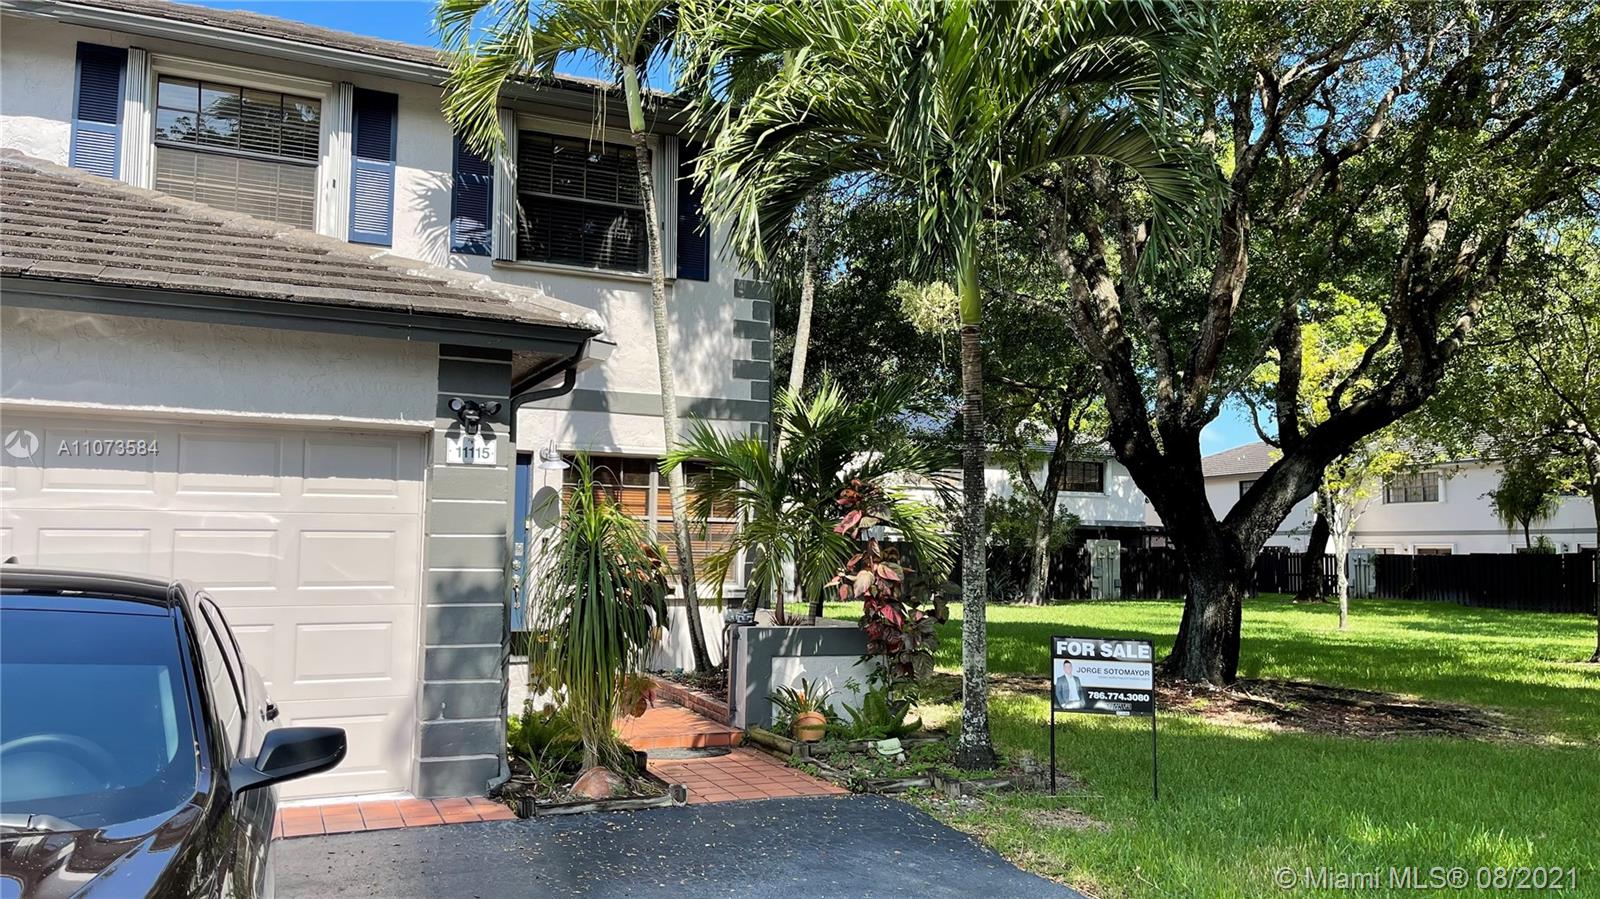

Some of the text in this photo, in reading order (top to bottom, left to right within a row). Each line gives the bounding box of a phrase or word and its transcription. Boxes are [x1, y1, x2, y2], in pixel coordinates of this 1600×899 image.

[456, 446, 490, 459] 11115
[1056, 641, 1151, 659] FOR SALE
[1076, 666, 1150, 676] JORGE SOTOMAYOR
[1087, 691, 1150, 702] 786.774.3080
